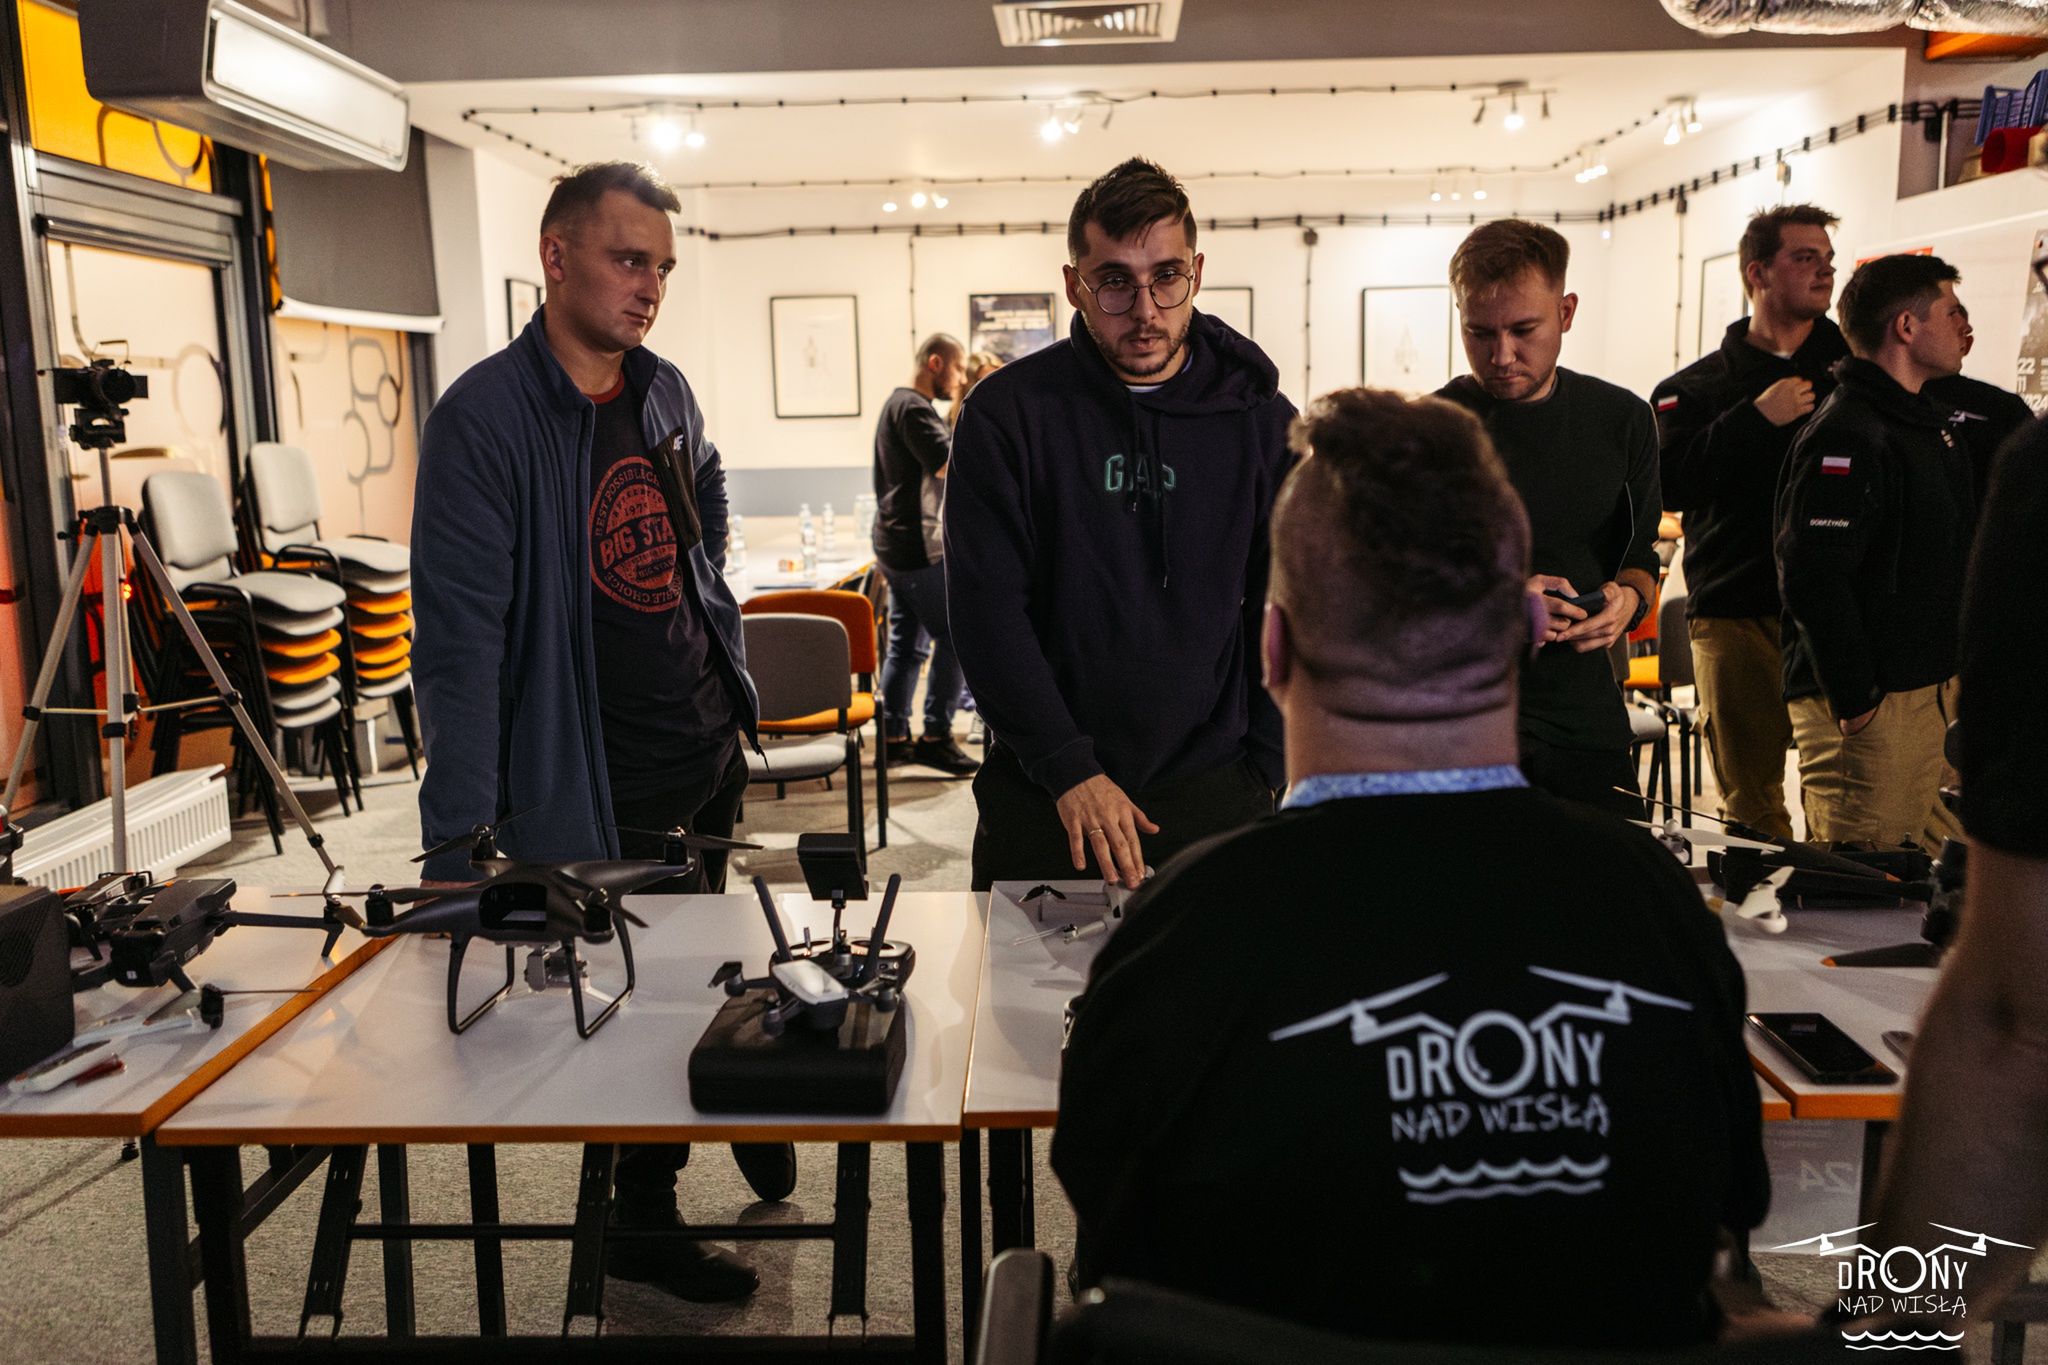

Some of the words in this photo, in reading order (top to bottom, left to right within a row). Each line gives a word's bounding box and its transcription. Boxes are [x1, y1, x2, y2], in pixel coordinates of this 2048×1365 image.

[2018, 357, 2036, 375] 22
[595, 498, 609, 536] BEST
[600, 525, 636, 569] BIG
[639, 515, 676, 545] STA
[604, 572, 650, 603] CHOICE
[1386, 1010, 1604, 1100] DRONY
[1392, 1101, 1470, 1143] NAD
